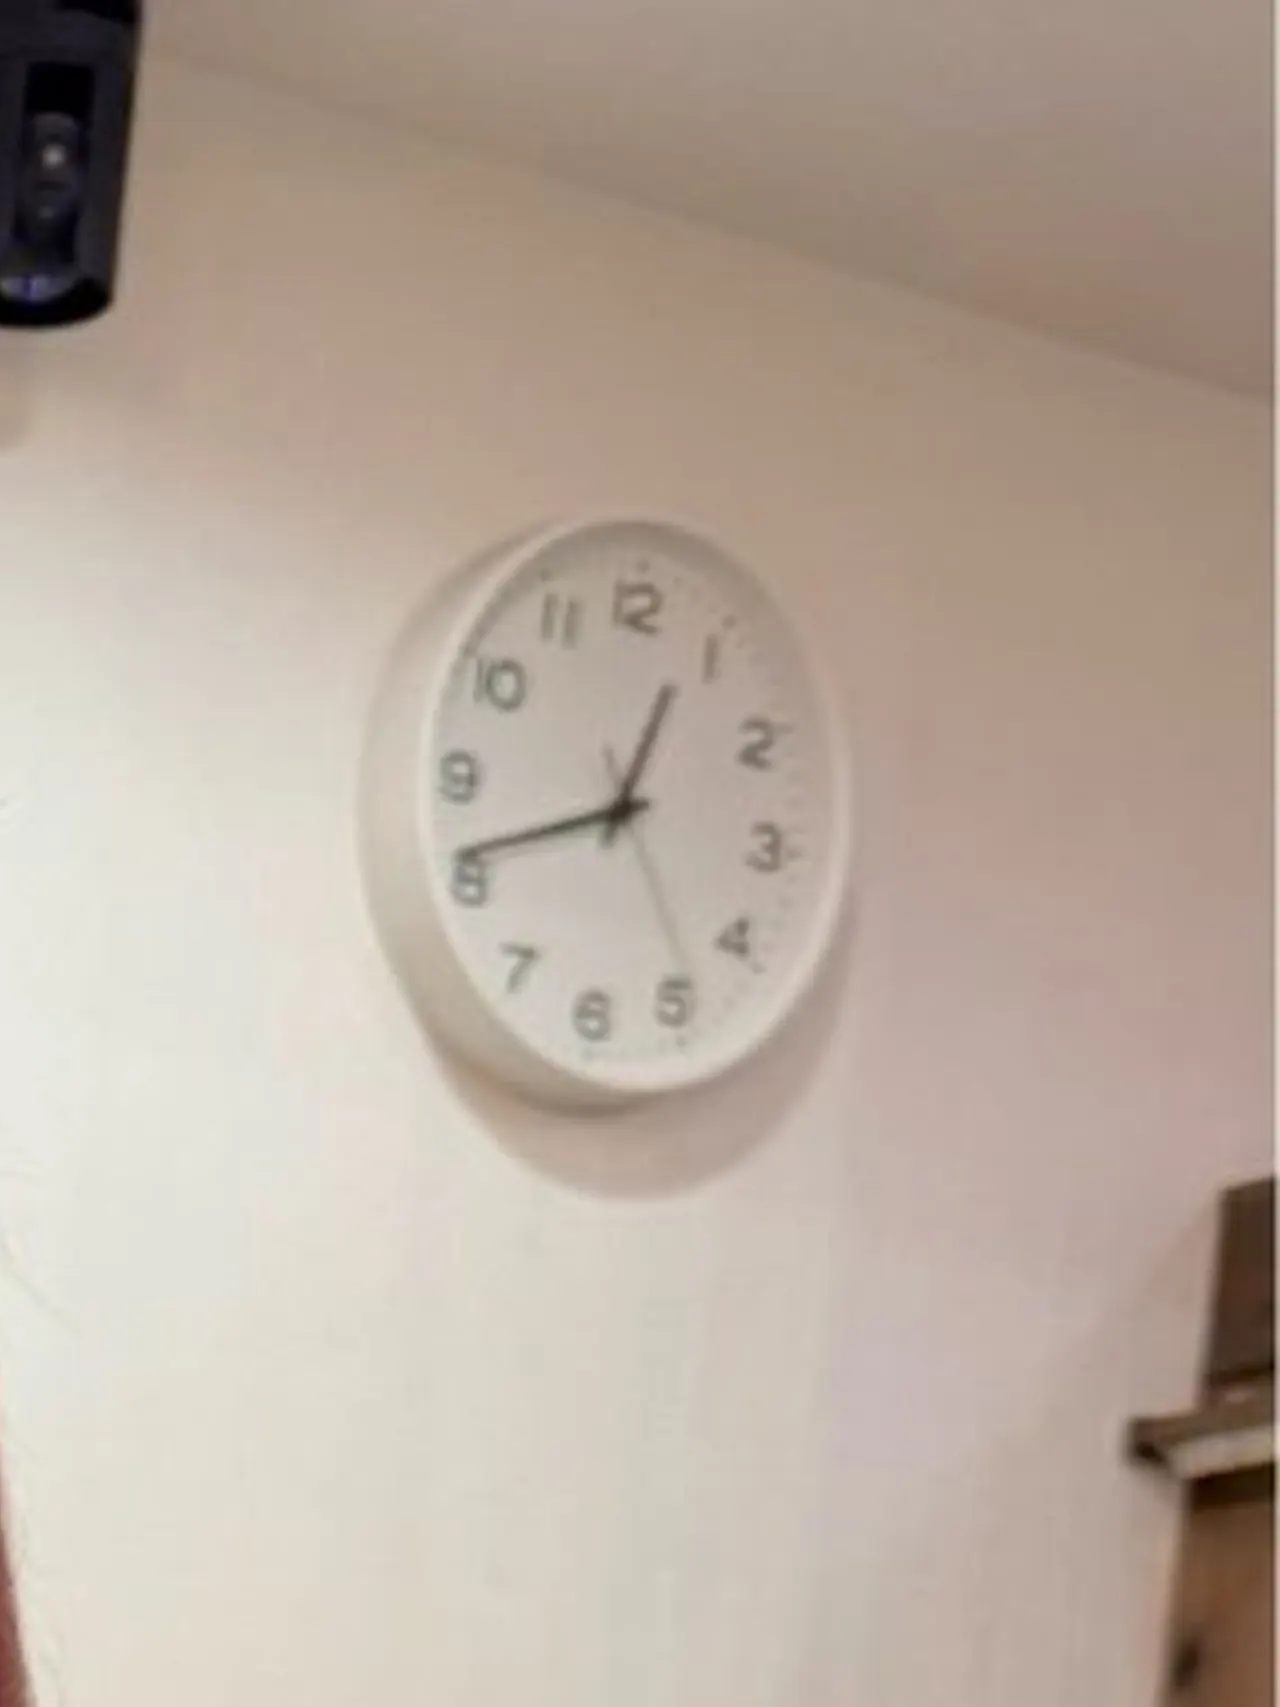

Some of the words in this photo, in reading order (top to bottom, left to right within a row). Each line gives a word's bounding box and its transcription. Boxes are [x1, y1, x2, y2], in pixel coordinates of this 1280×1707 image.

[541, 594, 581, 649] 11
[615, 581, 664, 636] 12
[474, 657, 528, 712] 10
[703, 634, 721, 684] 1
[738, 716, 776, 771] 2
[440, 749, 479, 805] 9
[744, 821, 782, 873] 3
[450, 850, 489, 909] 8
[713, 915, 750, 960] 4
[497, 943, 542, 995] 7
[572, 991, 611, 1042] 6
[654, 975, 692, 1027] 5
